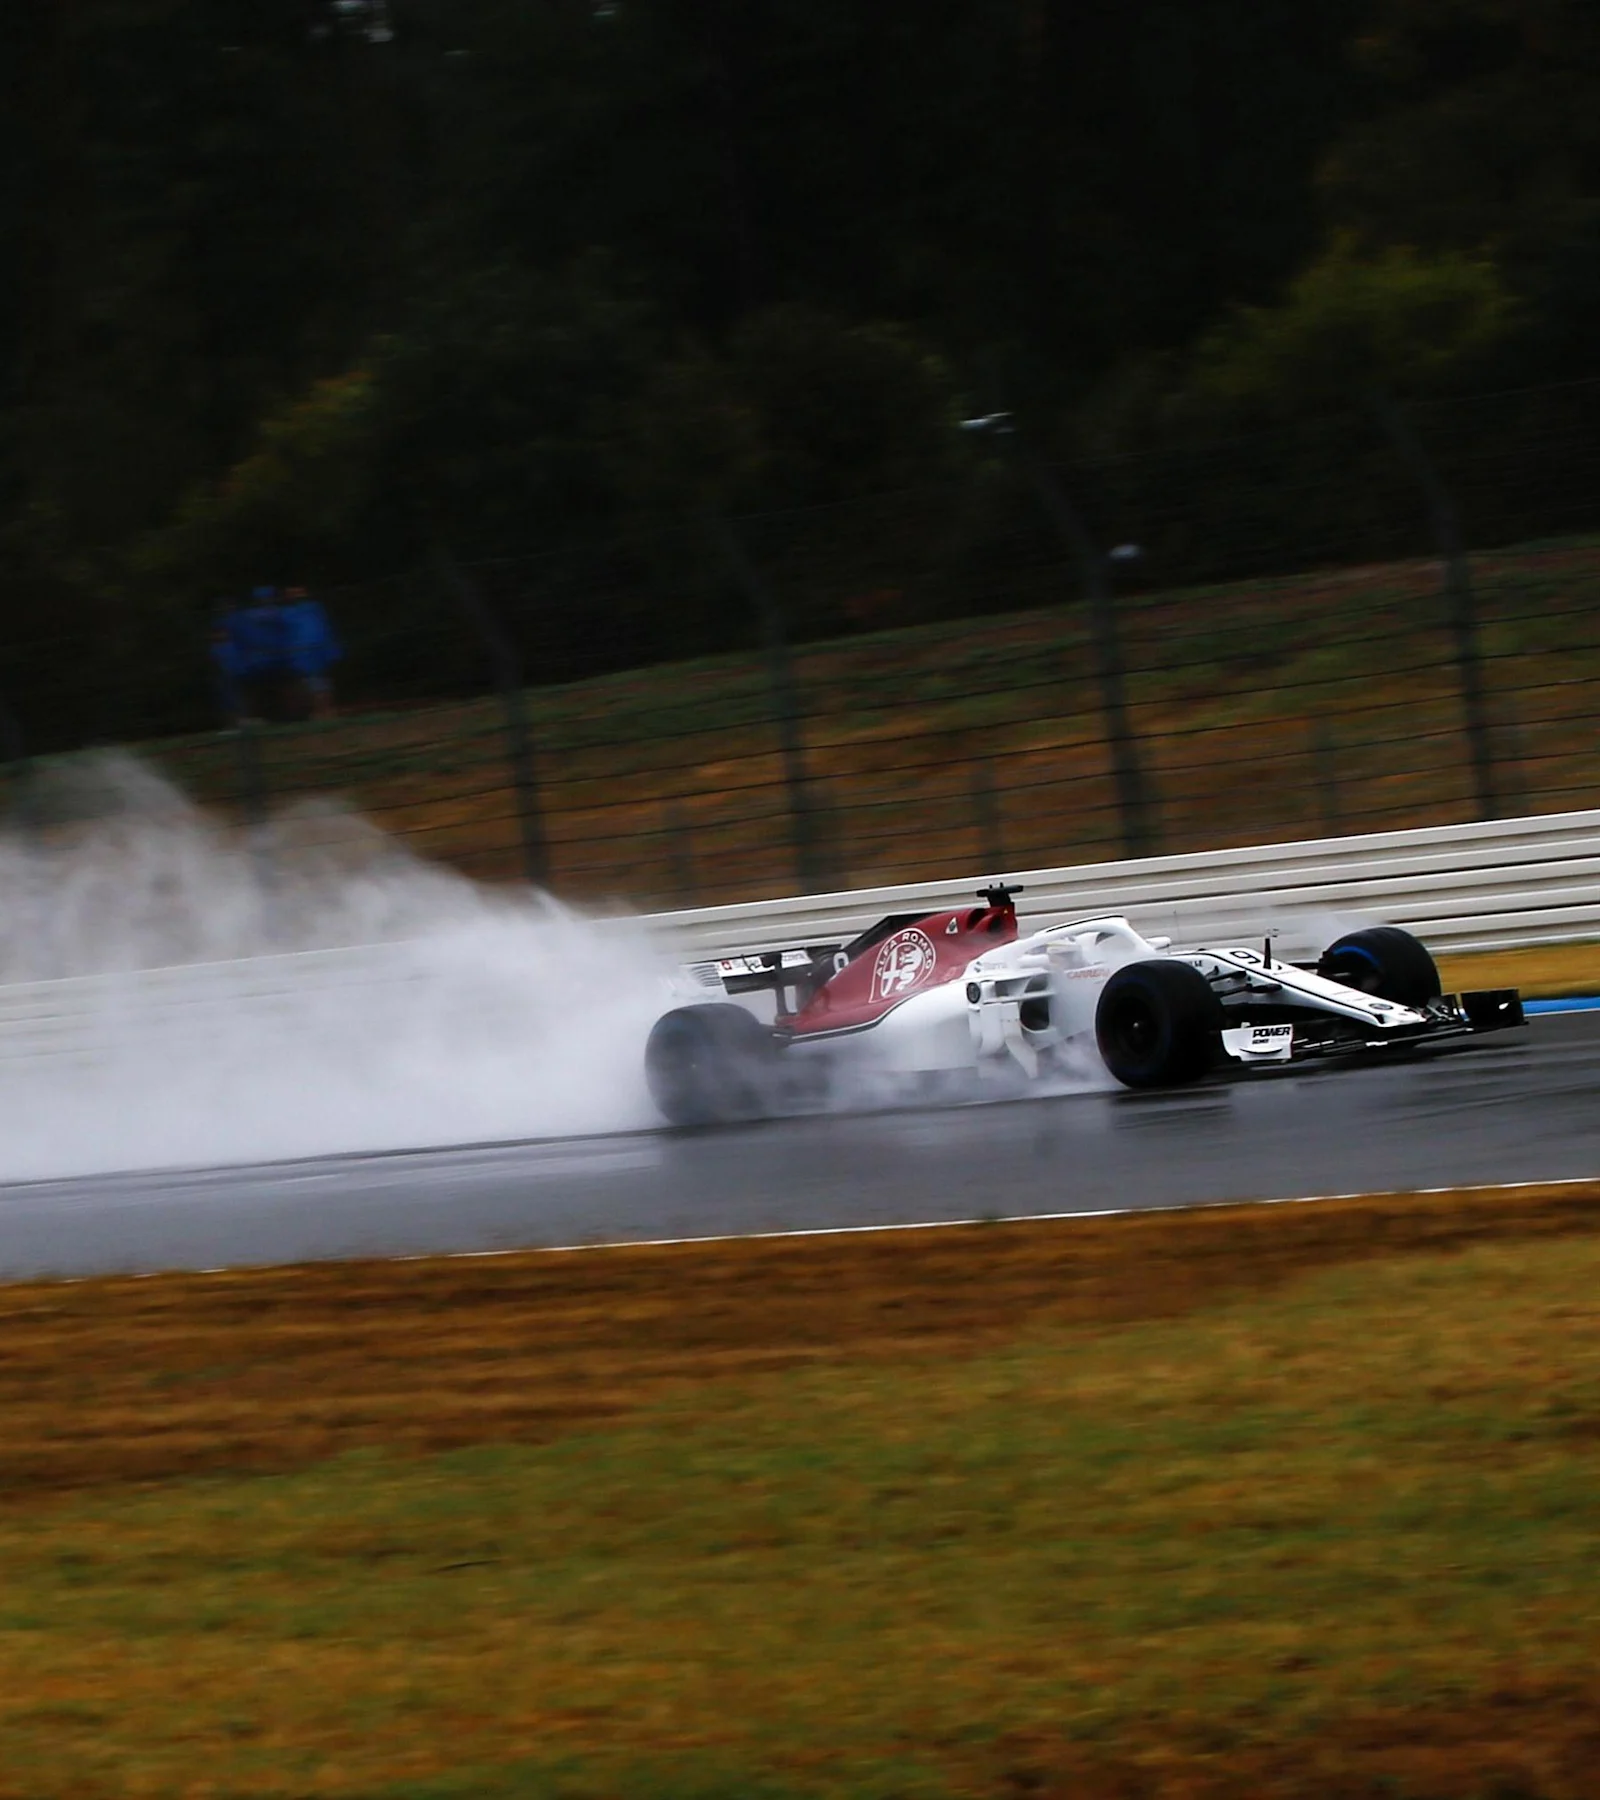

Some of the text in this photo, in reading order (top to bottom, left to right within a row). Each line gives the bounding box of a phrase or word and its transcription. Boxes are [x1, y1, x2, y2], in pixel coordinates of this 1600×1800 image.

[876, 932, 932, 977] ALFA ROMEO
[1229, 951, 1261, 964] 9
[1252, 1027, 1291, 1038] POWER
